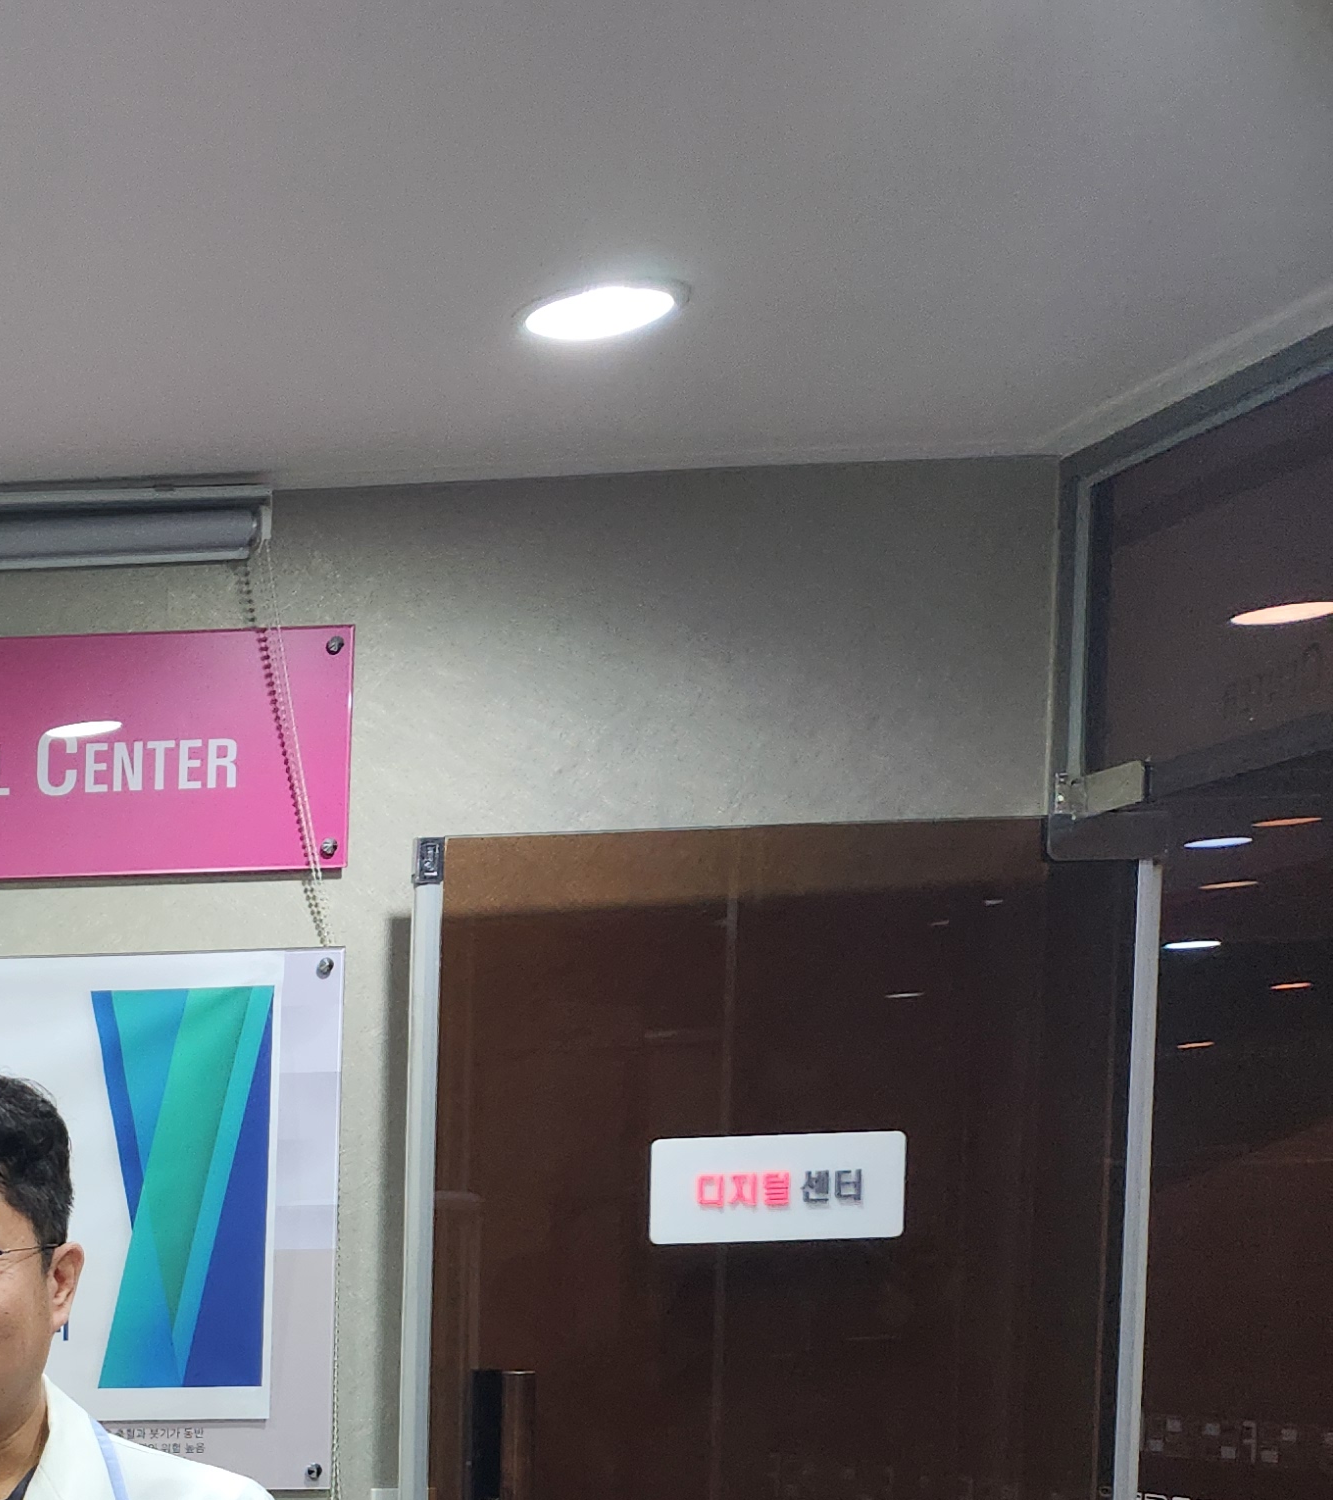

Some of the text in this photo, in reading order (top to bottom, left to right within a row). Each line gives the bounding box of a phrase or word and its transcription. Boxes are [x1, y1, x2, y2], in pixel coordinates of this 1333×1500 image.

[36, 731, 238, 797] CENTER
[696, 1168, 863, 1208] 디지털 센터
